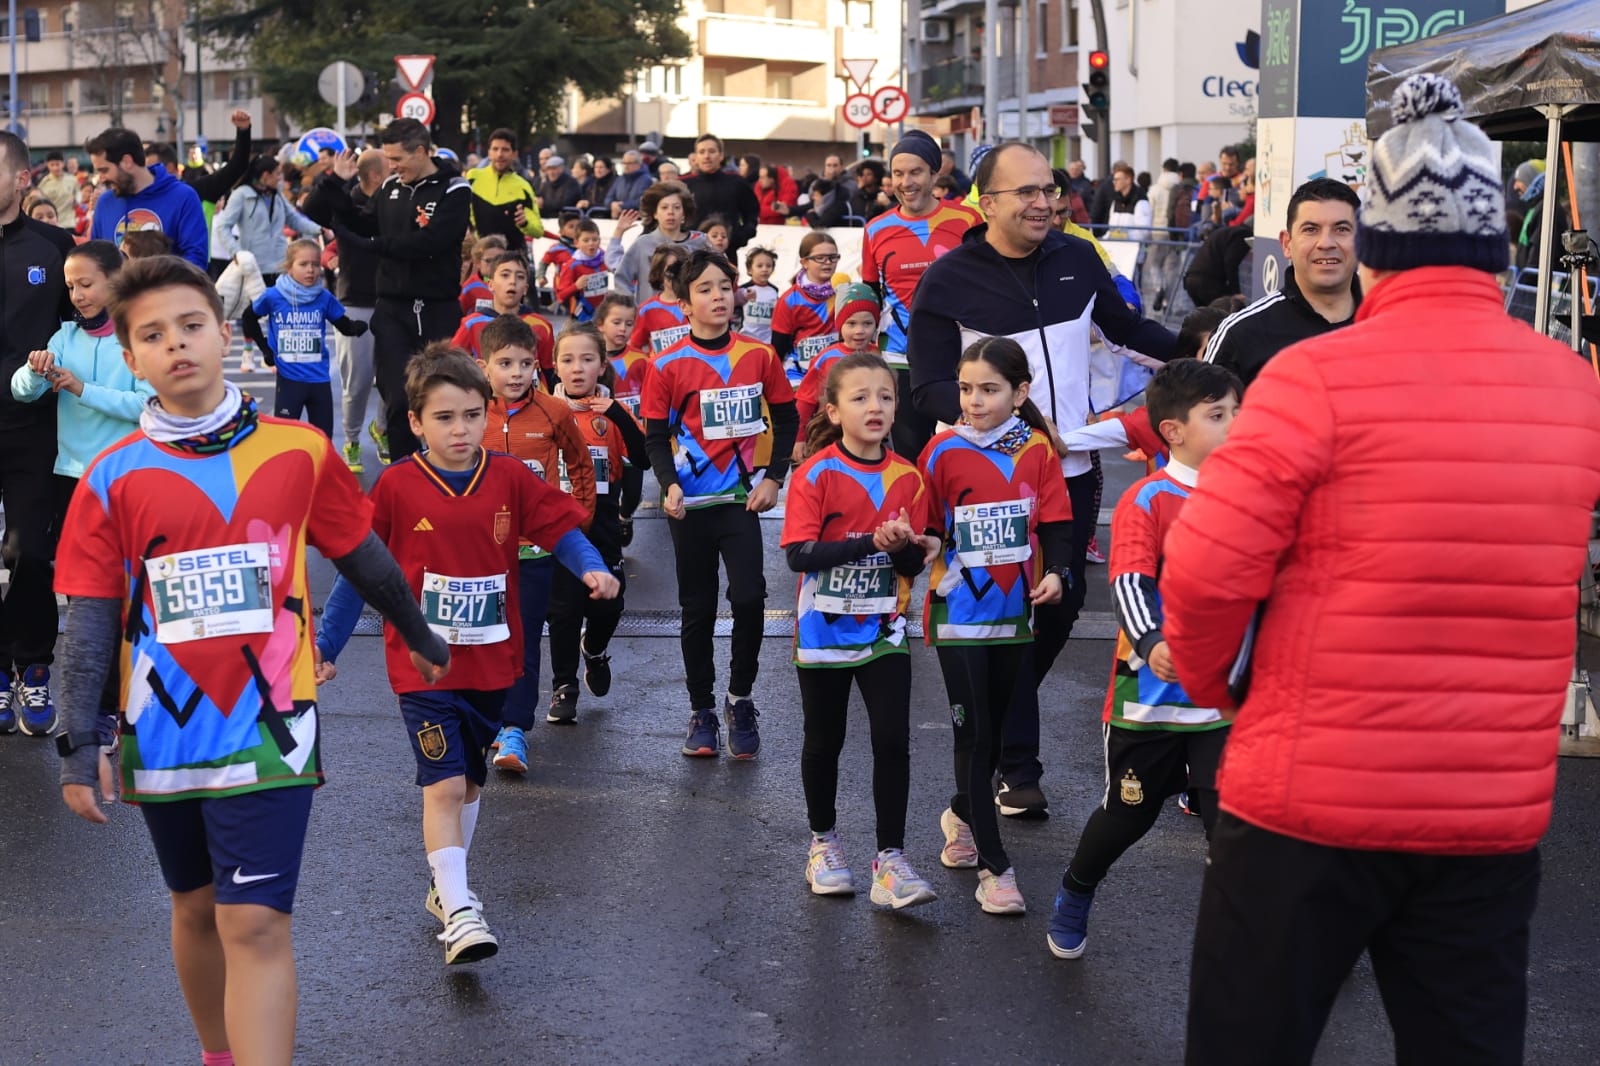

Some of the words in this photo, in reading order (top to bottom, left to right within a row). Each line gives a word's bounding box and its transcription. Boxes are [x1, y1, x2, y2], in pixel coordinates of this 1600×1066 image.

[1202, 76, 1260, 97] Clec
[405, 105, 426, 117] 30
[850, 104, 870, 116] 30
[286, 309, 322, 324] ARMUÑ
[283, 338, 313, 352] 6080
[714, 399, 753, 422] 6170
[976, 503, 1026, 518] SETEL
[969, 519, 1016, 546] 6314
[178, 550, 256, 572] SETEL
[448, 579, 500, 592] SETEL
[828, 566, 881, 594] 6454
[165, 569, 245, 614] 5959
[438, 594, 488, 622] 6217
